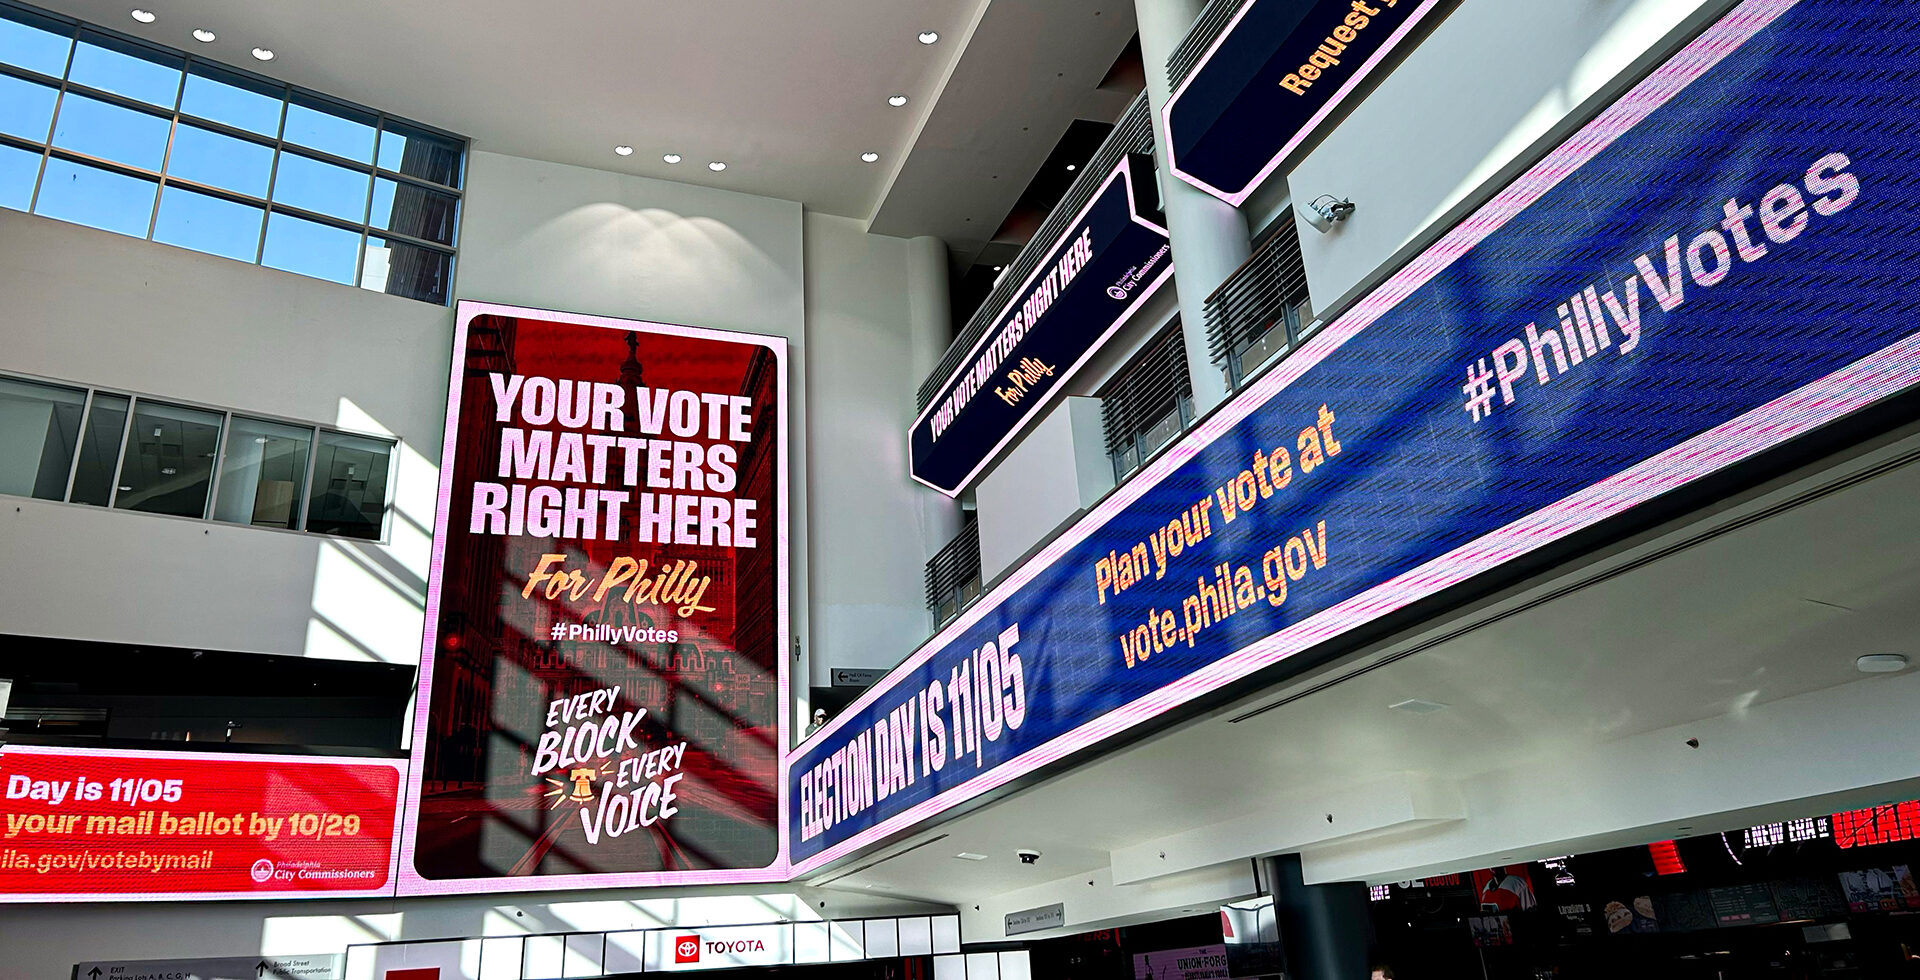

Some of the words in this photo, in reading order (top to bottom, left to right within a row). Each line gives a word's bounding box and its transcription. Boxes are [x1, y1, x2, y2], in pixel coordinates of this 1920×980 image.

[1279, 0, 1381, 96] Request
[1122, 280, 1138, 291] City
[1131, 243, 1170, 282] Commissioners
[1462, 151, 1861, 424] #PhillyVotes
[930, 393, 954, 443] YOUR
[952, 370, 977, 416] VOTE
[975, 311, 1024, 391] MATTERS
[1022, 268, 1060, 333] RIGHT
[1058, 226, 1093, 291] HERE
[994, 384, 1025, 407] For
[1008, 357, 1056, 391] Philly
[489, 372, 626, 432] YOUR
[636, 386, 752, 442] VOTE
[498, 427, 737, 493] MATTERS
[469, 482, 629, 541] RIGHT
[639, 492, 757, 548] HERE
[1095, 541, 1151, 606] Plan
[1149, 494, 1214, 582] your
[1215, 448, 1293, 525] vote
[1296, 402, 1342, 475] at
[521, 553, 595, 604] For
[593, 556, 716, 618] Philly
[1120, 519, 1327, 670] vote.phila.gov
[551, 622, 679, 645] #PhillyVotes
[546, 685, 621, 727] EVERY
[531, 708, 648, 777] BLOCK
[801, 728, 873, 843] ELECTION
[874, 696, 916, 803] DAY
[918, 679, 947, 778] IS
[947, 622, 1026, 769] 11/05
[616, 741, 687, 789] EVERY
[6, 774, 72, 805] Day
[75, 776, 103, 802] is
[109, 778, 183, 806] 11/05
[579, 773, 684, 845] VOICE
[4, 812, 82, 839] your
[85, 811, 154, 835] mail
[158, 811, 244, 836] ballot
[247, 813, 284, 841] by
[287, 813, 361, 840] 10/29
[1751, 821, 1784, 847] NEW
[1787, 817, 1817, 843] ERA
[0, 848, 214, 874] ila.gov/votebymail
[274, 869, 297, 882] City
[297, 868, 376, 880] Commissioners
[110, 966, 125, 974] EXIT
[272, 968, 290, 976] Public
[291, 966, 332, 976] Transportation
[706, 940, 764, 954] TOYOTA
